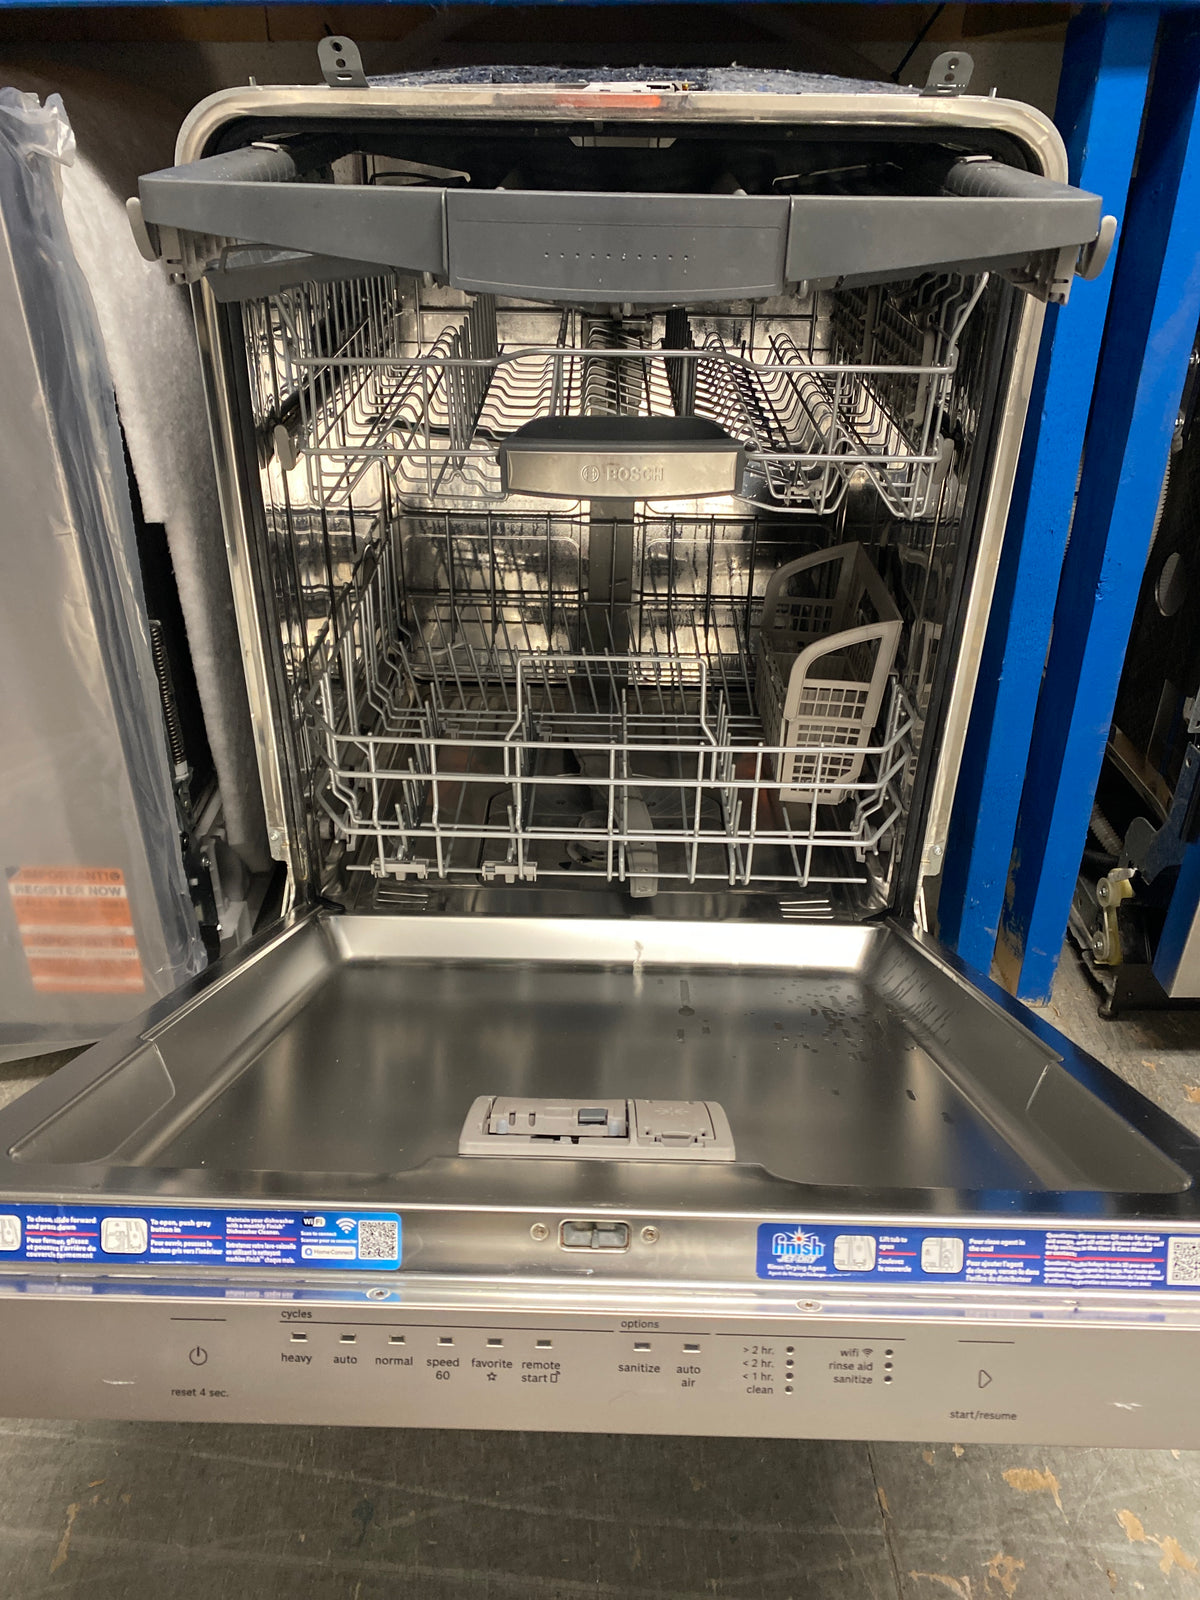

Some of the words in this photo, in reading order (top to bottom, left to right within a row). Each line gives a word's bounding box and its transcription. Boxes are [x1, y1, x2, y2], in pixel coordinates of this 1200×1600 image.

[606, 466, 664, 481] BOSCH
[88, 886, 122, 897] NOW
[771, 1232, 826, 1257] finish
[281, 1309, 313, 1319] cycles
[621, 1320, 660, 1330] options
[752, 1346, 759, 1355] 2
[761, 1346, 775, 1356] hr.
[840, 1348, 860, 1358] wifi
[281, 1352, 313, 1365] heavy
[333, 1355, 358, 1365] auto
[375, 1356, 414, 1366] normal
[426, 1357, 460, 1368] speed
[471, 1358, 513, 1369] favorite
[521, 1361, 561, 1371] remote
[618, 1363, 661, 1374] sanitize
[751, 1359, 759, 1368] 2
[760, 1359, 774, 1369] hr.
[828, 1361, 855, 1371] rinse
[857, 1362, 873, 1372] aid
[676, 1365, 701, 1375] auto
[435, 1370, 450, 1381] 60
[521, 1374, 548, 1384] start
[760, 1372, 774, 1382] hr.
[833, 1374, 873, 1385] sanitize
[681, 1378, 696, 1388] air
[171, 1388, 197, 1398] reset
[199, 1388, 206, 1397] 4
[209, 1389, 229, 1398] sec.
[746, 1385, 774, 1395] clean
[949, 1410, 1018, 1421] start/resume
